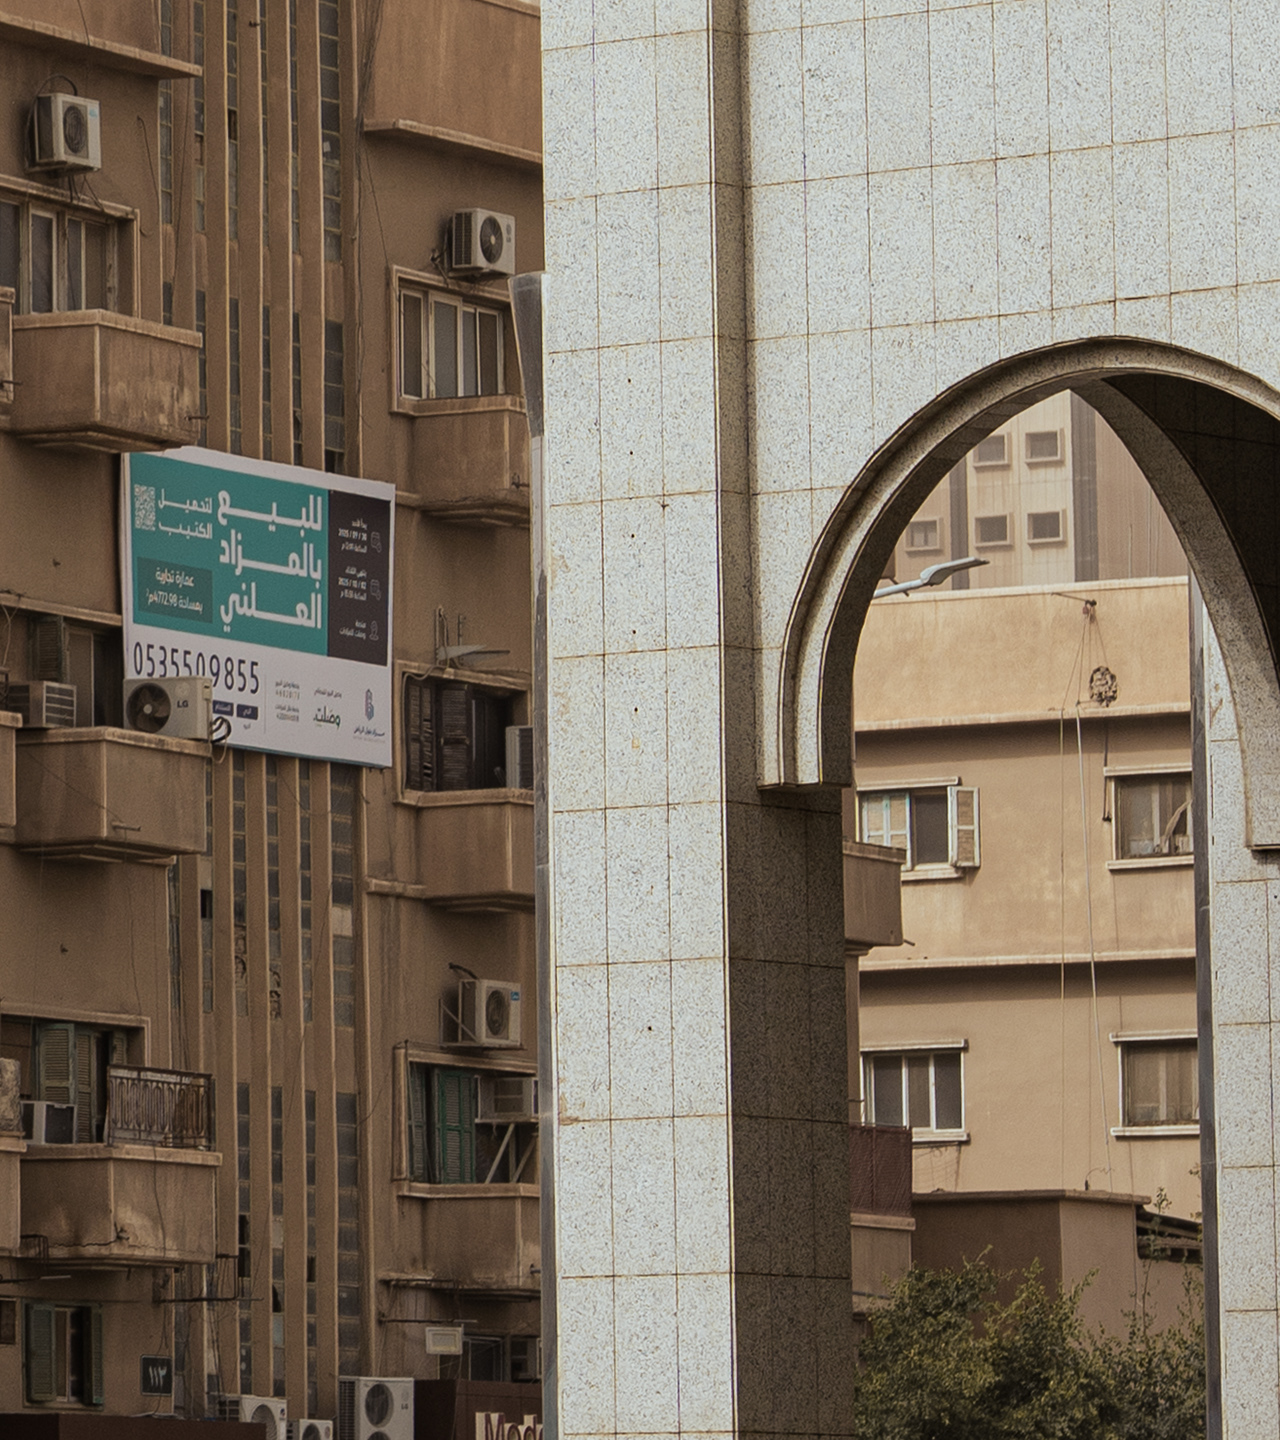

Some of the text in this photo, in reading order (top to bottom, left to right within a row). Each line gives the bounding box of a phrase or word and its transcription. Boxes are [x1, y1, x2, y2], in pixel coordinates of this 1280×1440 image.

[158, 488, 212, 513] لتحميل
[217, 489, 323, 538] للبيع
[158, 522, 212, 539] الكتيب
[219, 530, 322, 588] بالمزاد
[220, 583, 322, 633] العلني
[177, 700, 189, 708] LG
